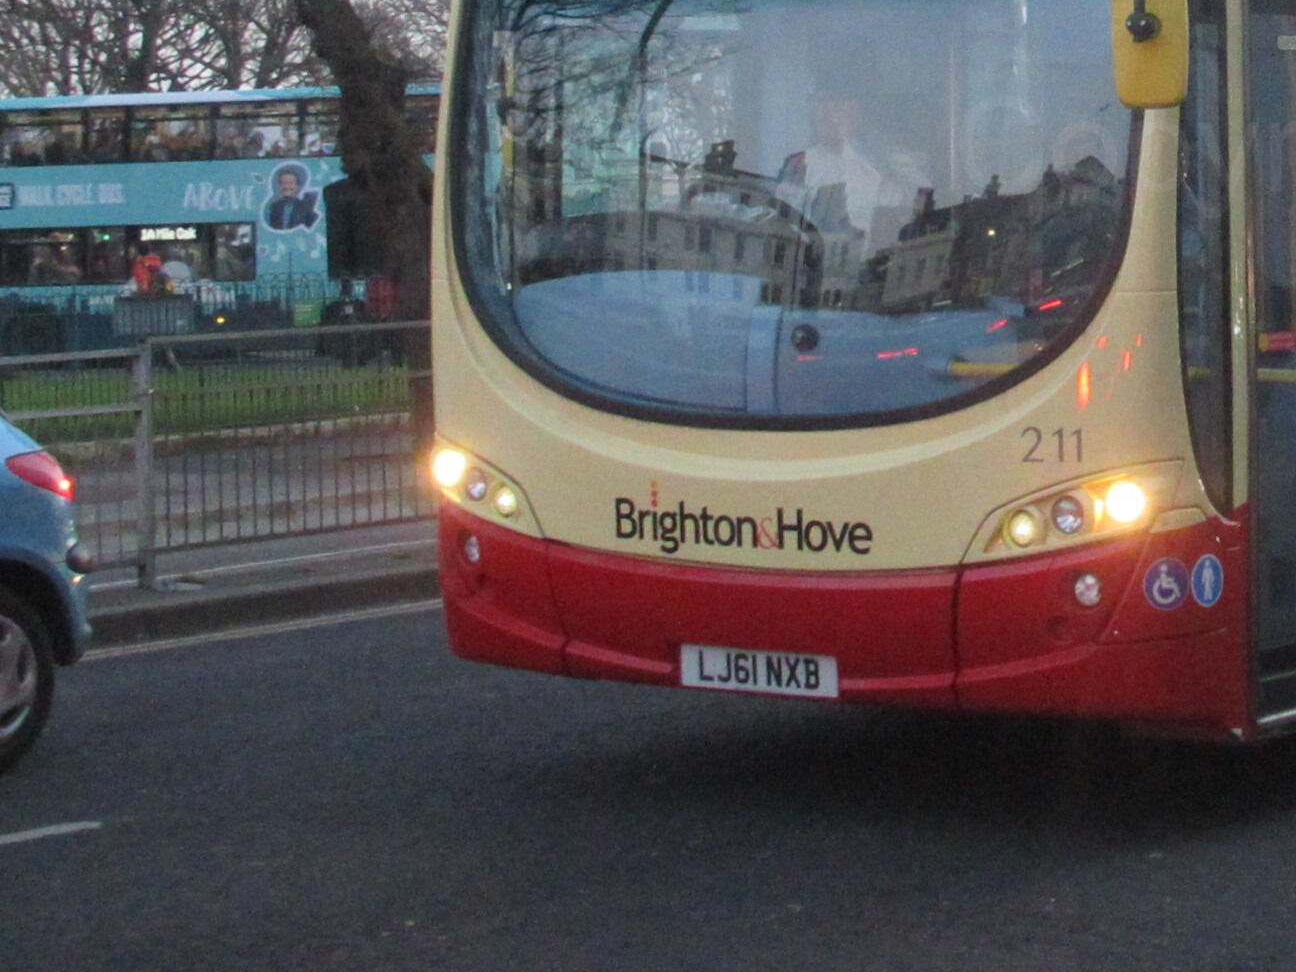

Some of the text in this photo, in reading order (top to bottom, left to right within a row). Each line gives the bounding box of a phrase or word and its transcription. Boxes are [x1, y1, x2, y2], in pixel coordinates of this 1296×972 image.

[182, 182, 256, 212] ABOVE
[1020, 426, 1084, 463] 211
[615, 481, 873, 554] Brighton&Hove
[698, 649, 820, 690] LJ61 NXB
